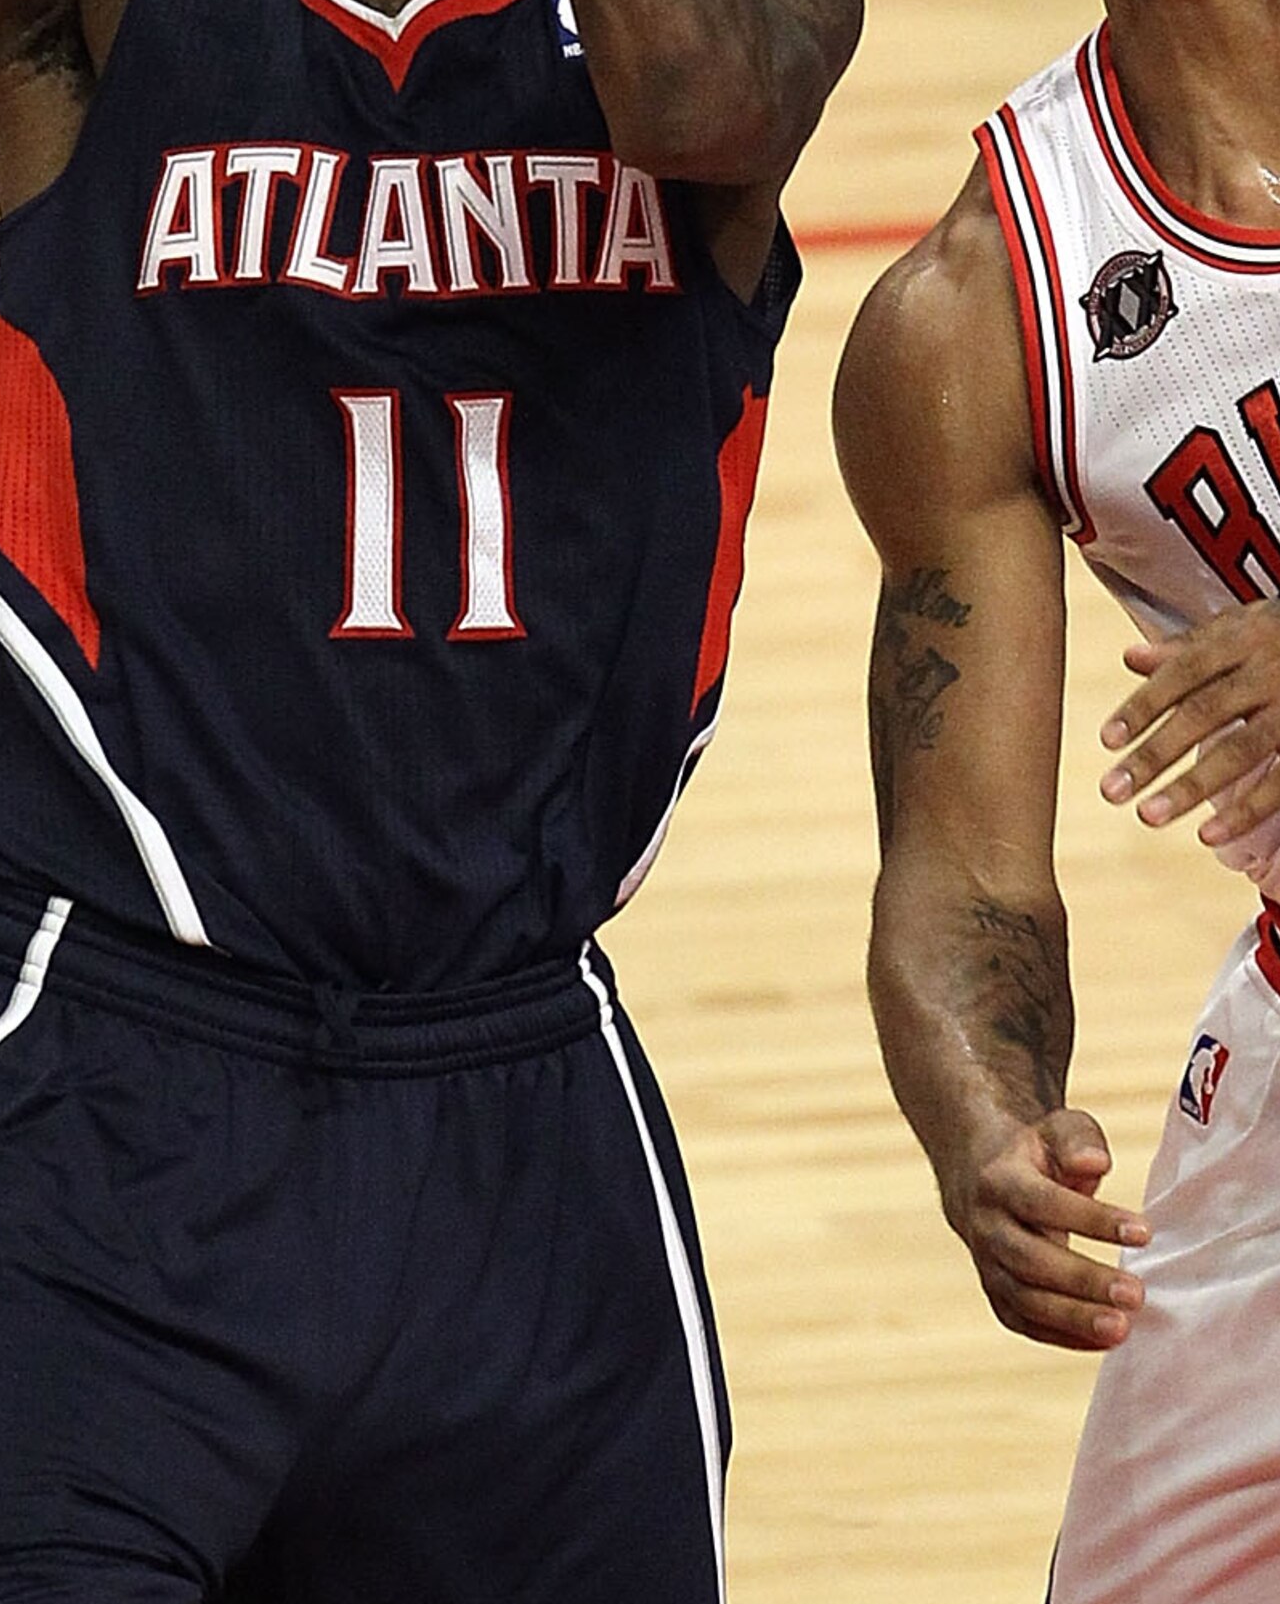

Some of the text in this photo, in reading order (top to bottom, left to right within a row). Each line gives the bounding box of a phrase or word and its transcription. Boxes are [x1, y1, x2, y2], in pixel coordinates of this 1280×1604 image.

[562, 43, 585, 58] NB
[135, 142, 680, 298] ATLANTA
[328, 388, 527, 639] 11
